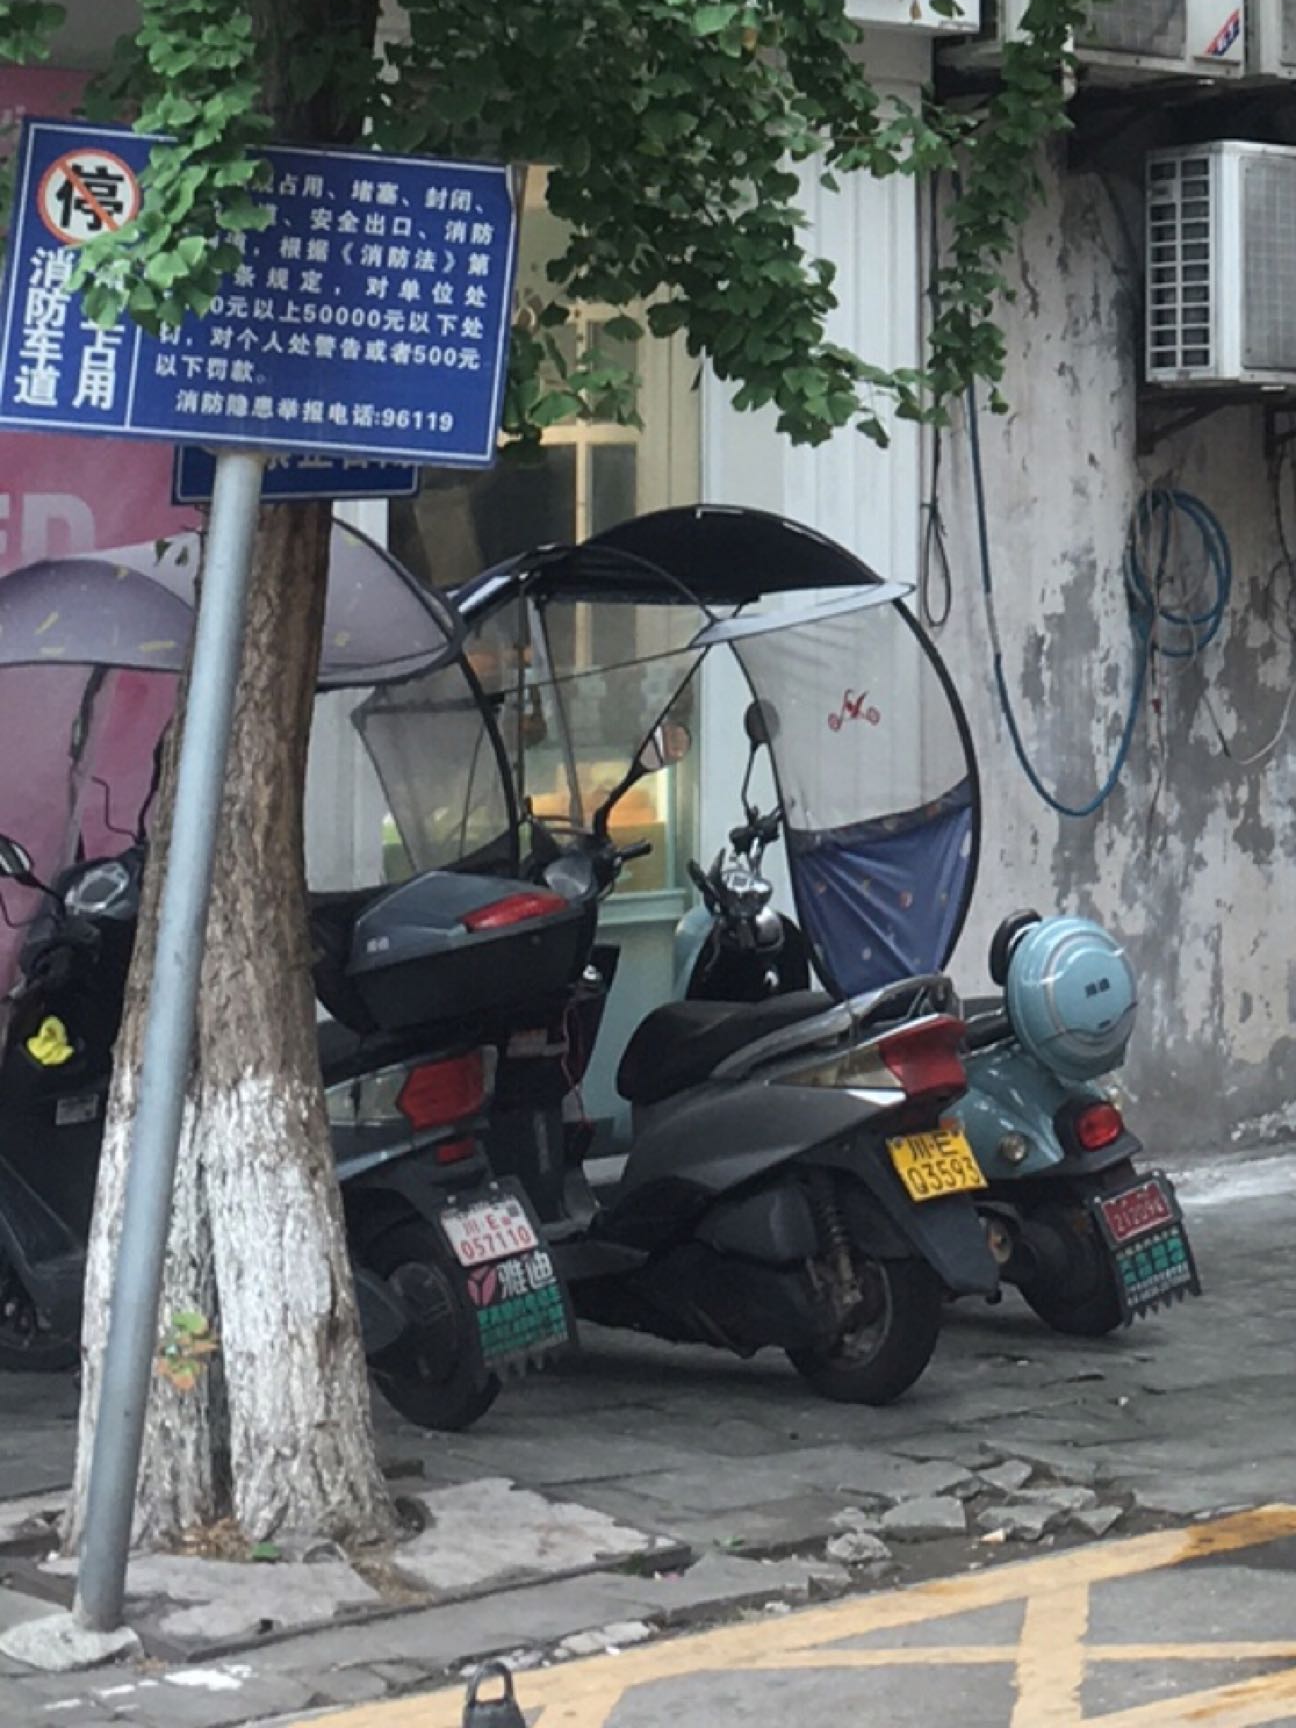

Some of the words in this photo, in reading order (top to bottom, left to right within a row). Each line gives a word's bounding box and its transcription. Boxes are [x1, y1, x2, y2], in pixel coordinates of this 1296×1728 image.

[56, 163, 124, 231] 停
[13, 246, 74, 407] 消防车道
[155, 353, 266, 384] 以下罚款。
[460, 1224, 532, 1260] 057110
[496, 1248, 557, 1300] 雅迪
